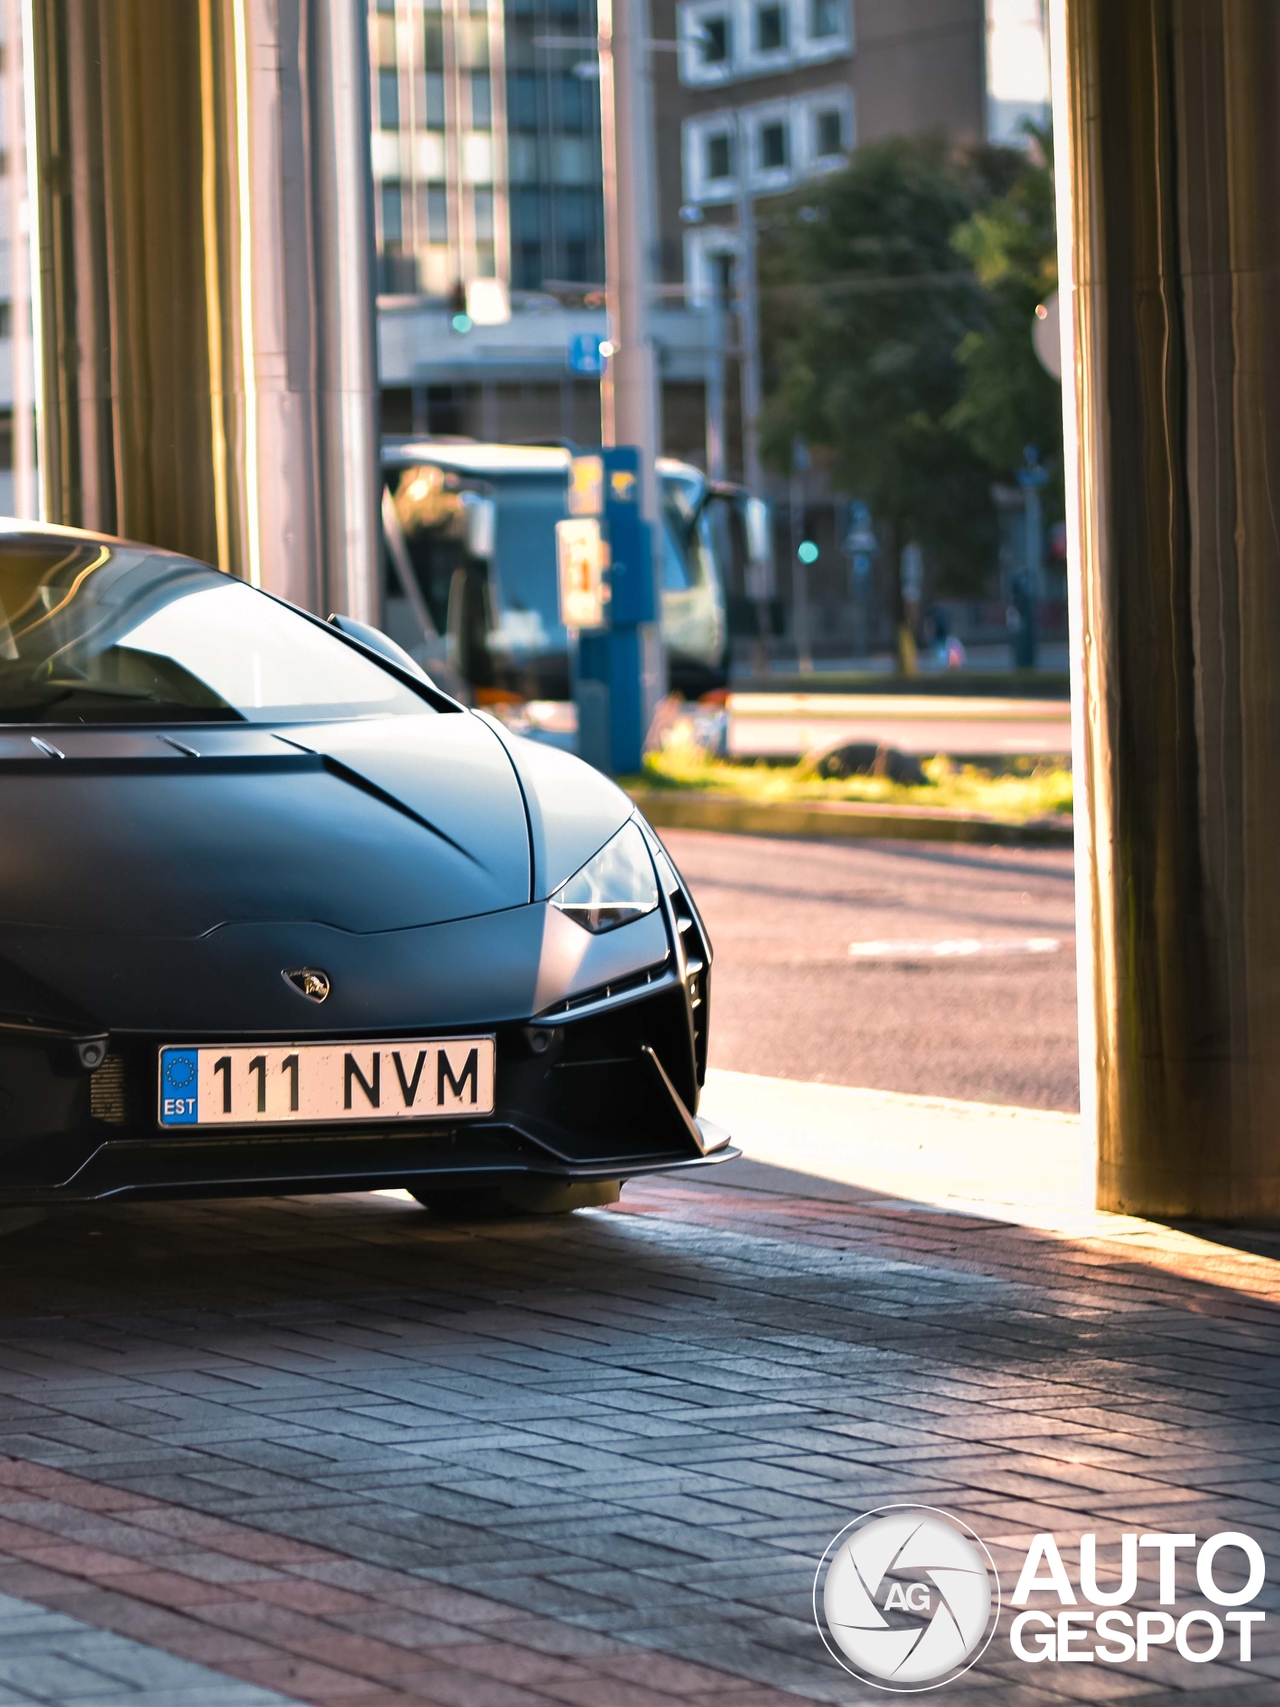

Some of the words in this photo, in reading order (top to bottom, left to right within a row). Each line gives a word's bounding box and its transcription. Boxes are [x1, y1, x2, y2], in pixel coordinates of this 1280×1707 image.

[213, 1056, 299, 1113] 111
[343, 1048, 478, 1110] NVM
[164, 1098, 196, 1115] EST
